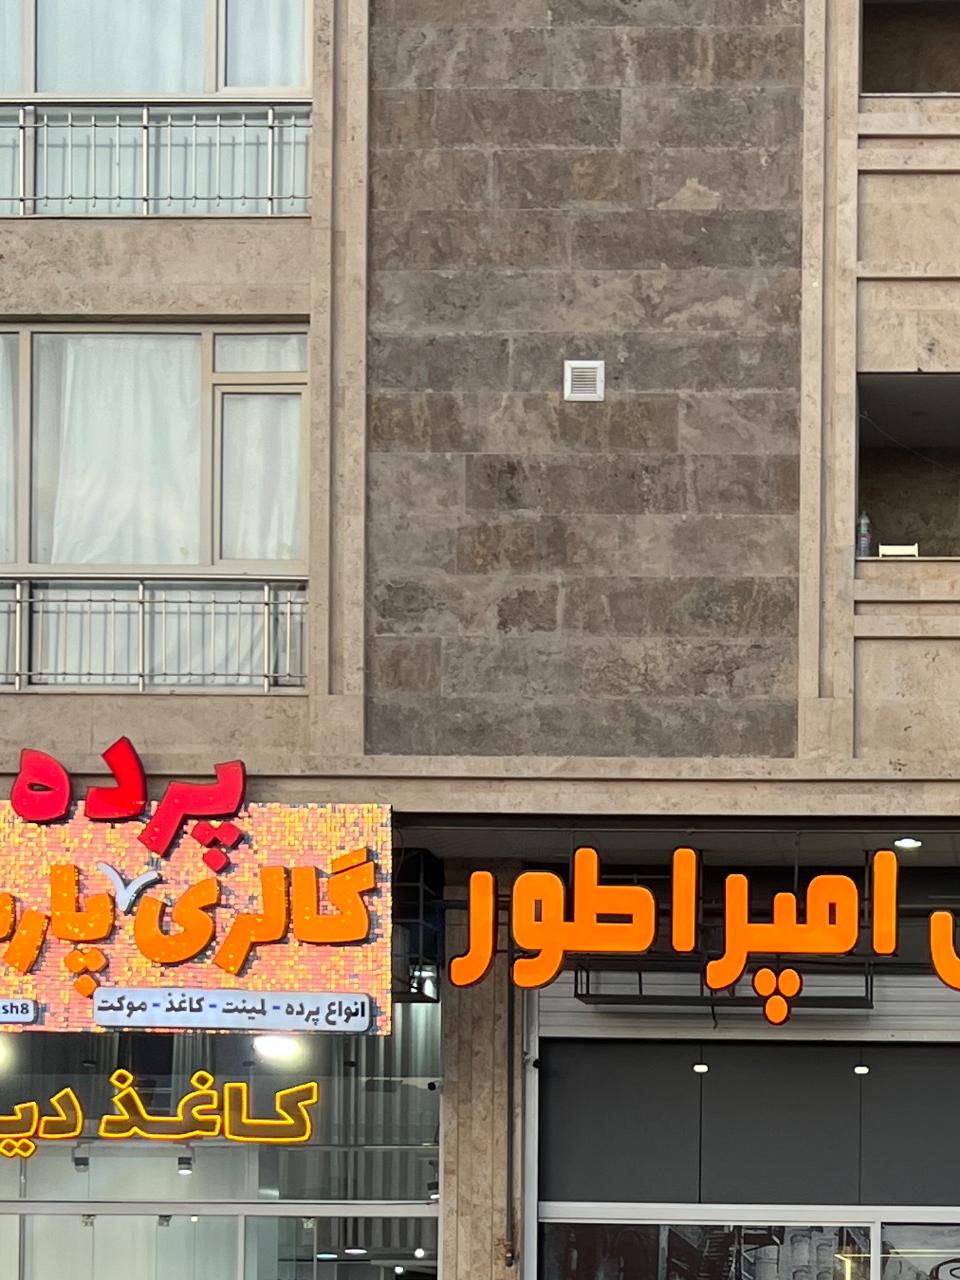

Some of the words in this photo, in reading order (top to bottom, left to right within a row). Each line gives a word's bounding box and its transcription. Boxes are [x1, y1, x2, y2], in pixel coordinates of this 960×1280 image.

[10, 736, 245, 873] پرده
[133, 848, 376, 976] گالری
[449, 847, 898, 1024] امپراطور
[97, 996, 147, 1014] موکت
[165, 991, 205, 1014] کاغذ
[222, 997, 267, 1020] لمینت
[285, 1002, 320, 1025] پرده
[325, 1000, 366, 1025] انواع
[0, 1087, 84, 1159] دی
[99, 1068, 319, 1143] کاغذ
